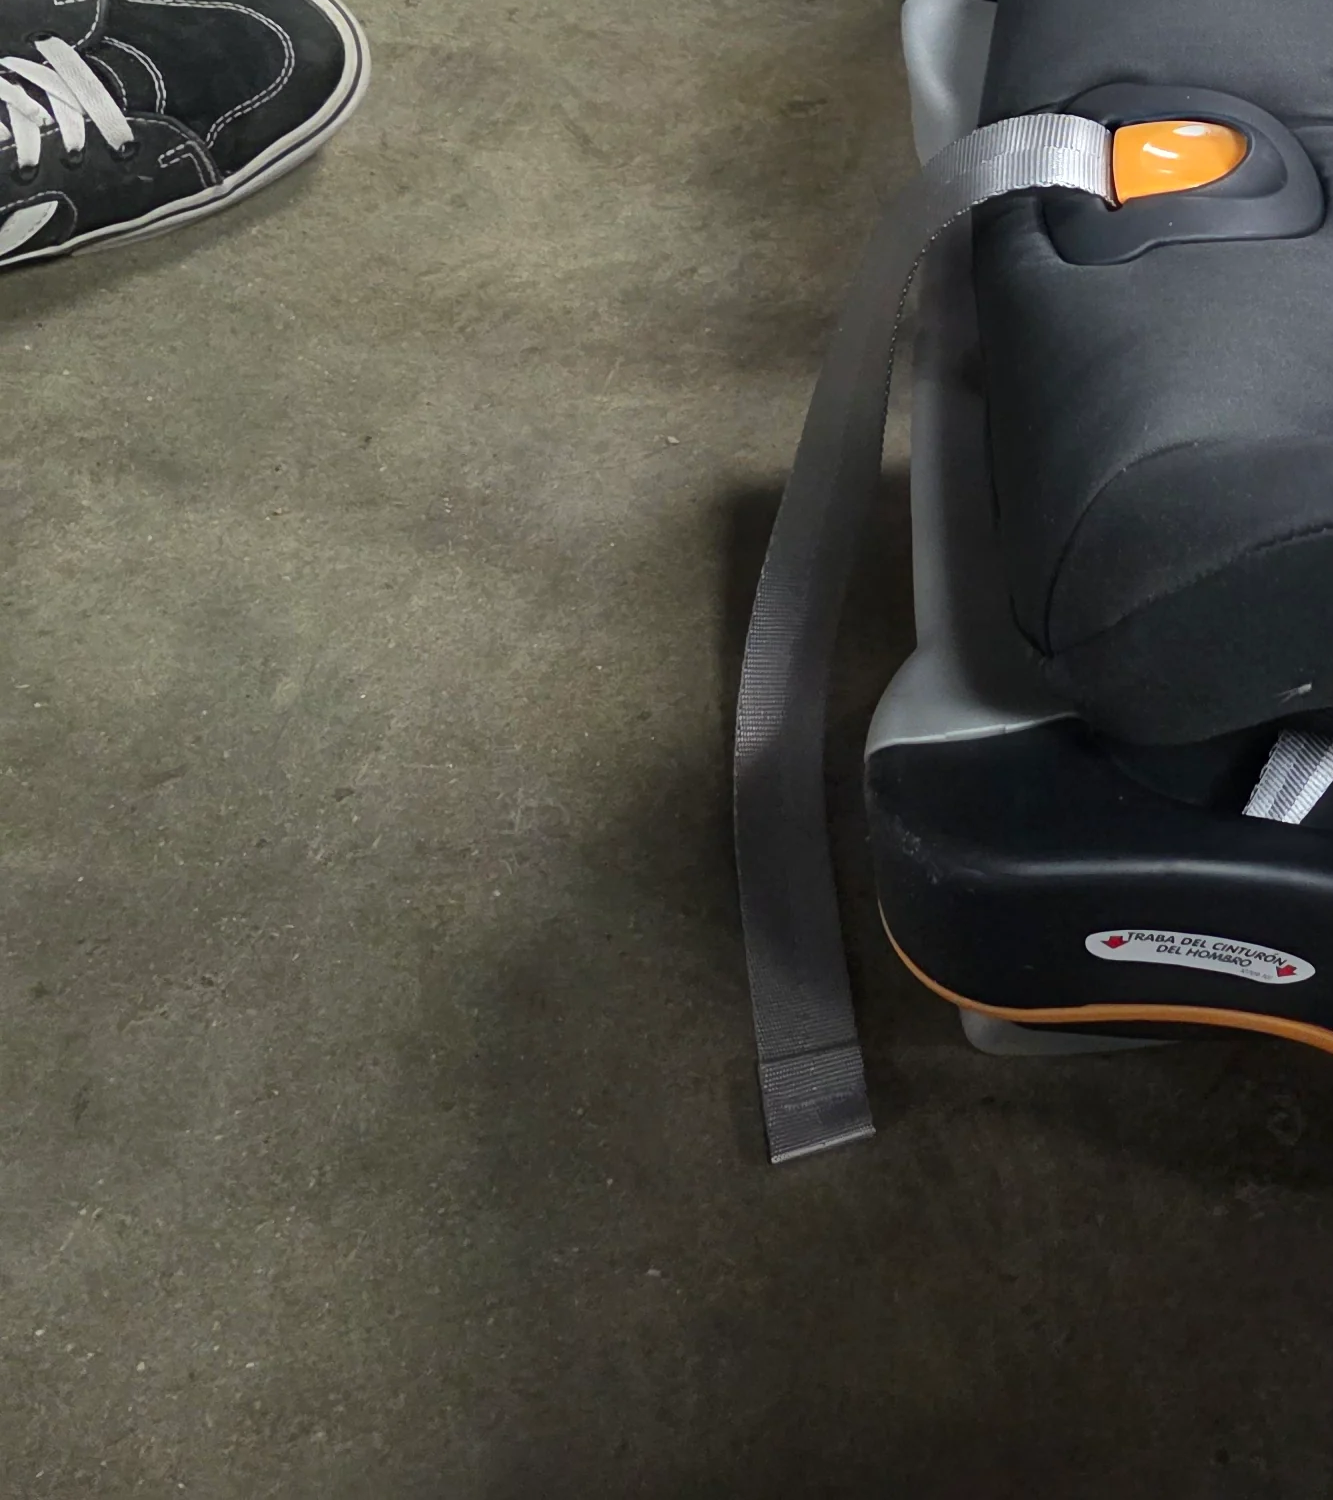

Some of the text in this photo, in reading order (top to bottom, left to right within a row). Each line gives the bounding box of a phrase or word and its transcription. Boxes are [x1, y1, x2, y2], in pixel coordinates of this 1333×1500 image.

[1127, 931, 1288, 966] TRABA DEL CINTURÓN
[1156, 944, 1252, 968] DEL HOMBRO
